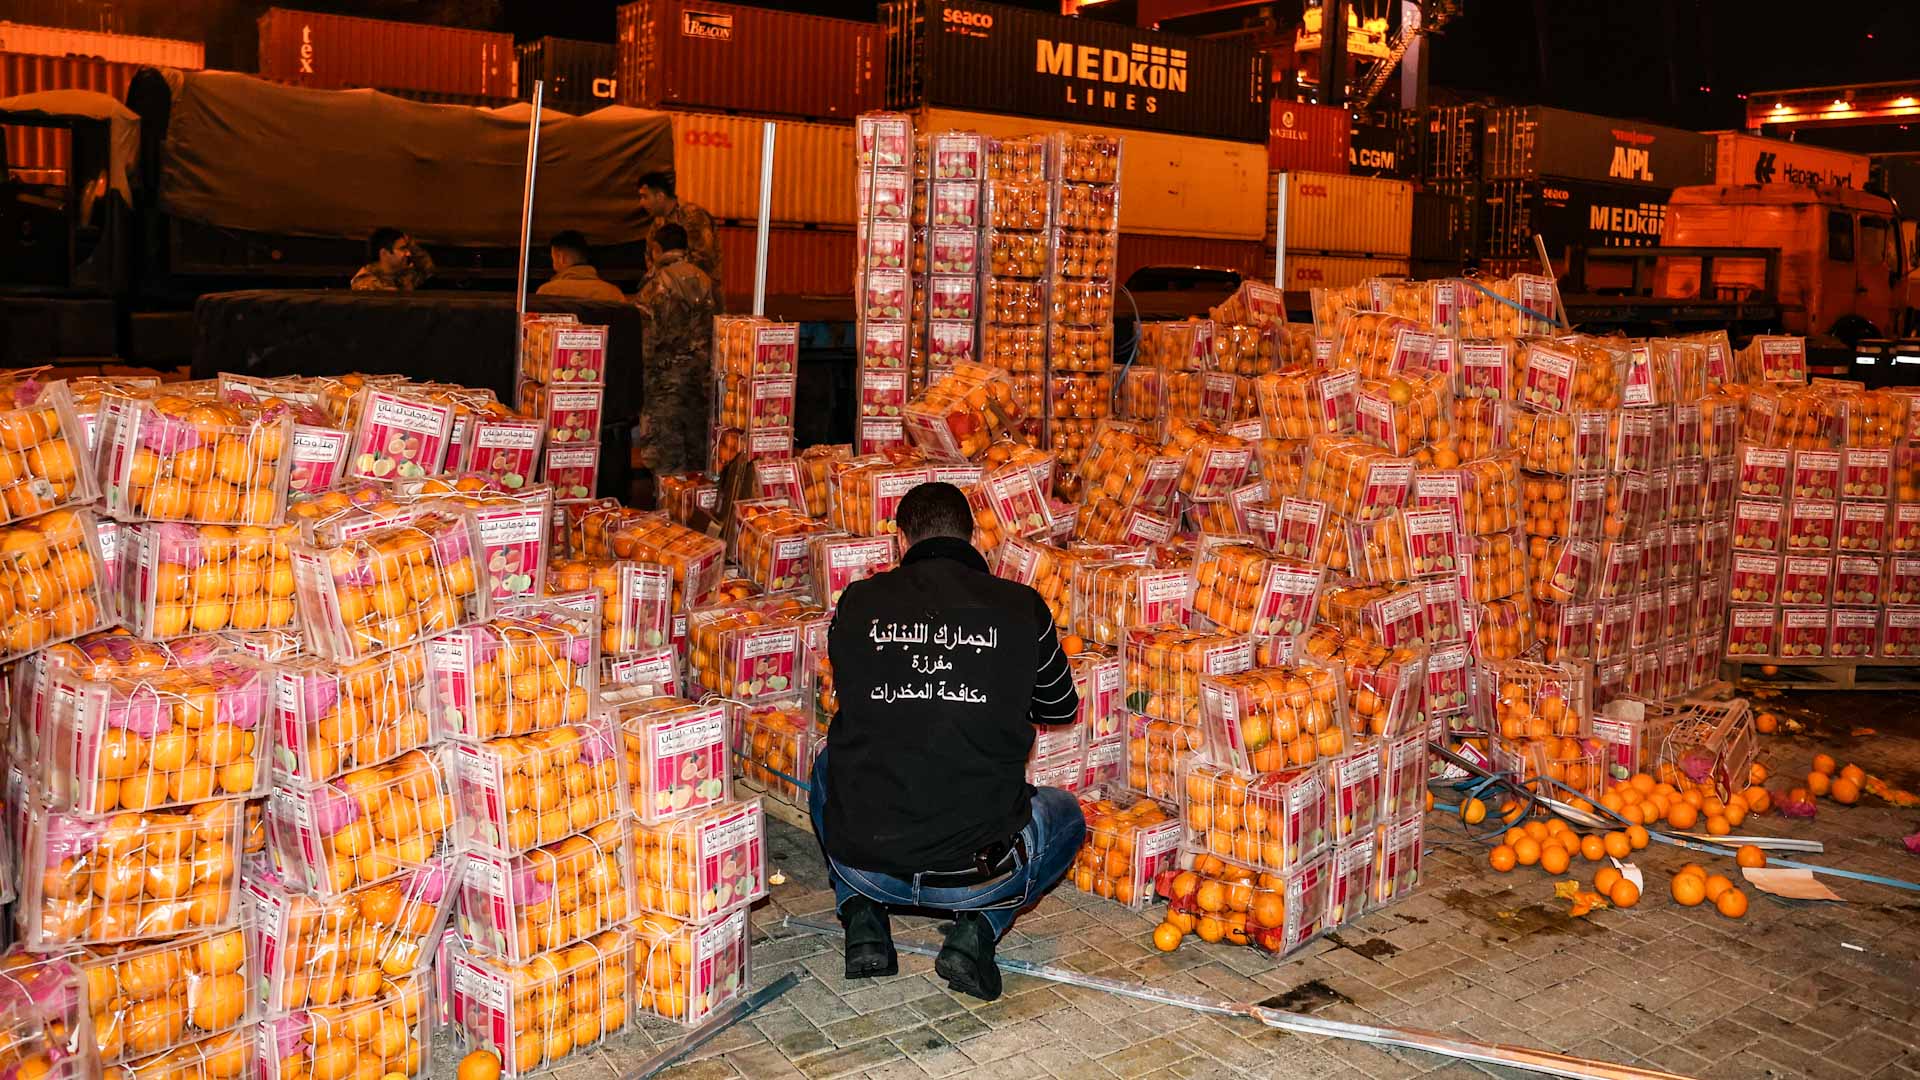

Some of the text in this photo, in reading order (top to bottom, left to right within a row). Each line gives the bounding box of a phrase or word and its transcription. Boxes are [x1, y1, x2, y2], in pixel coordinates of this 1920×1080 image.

[943, 7, 993, 28] seaco
[1037, 39, 1187, 92] MEDKON
[1067, 86, 1157, 113] LINES
[1360, 148, 1395, 169] CGM
[1609, 146, 1654, 181] APL
[1543, 188, 1569, 200] seaco
[868, 619, 998, 654] الجمارك اللبنانية
[911, 655, 953, 674] مفرزة
[870, 681, 987, 704] مكافحة المخدرات
